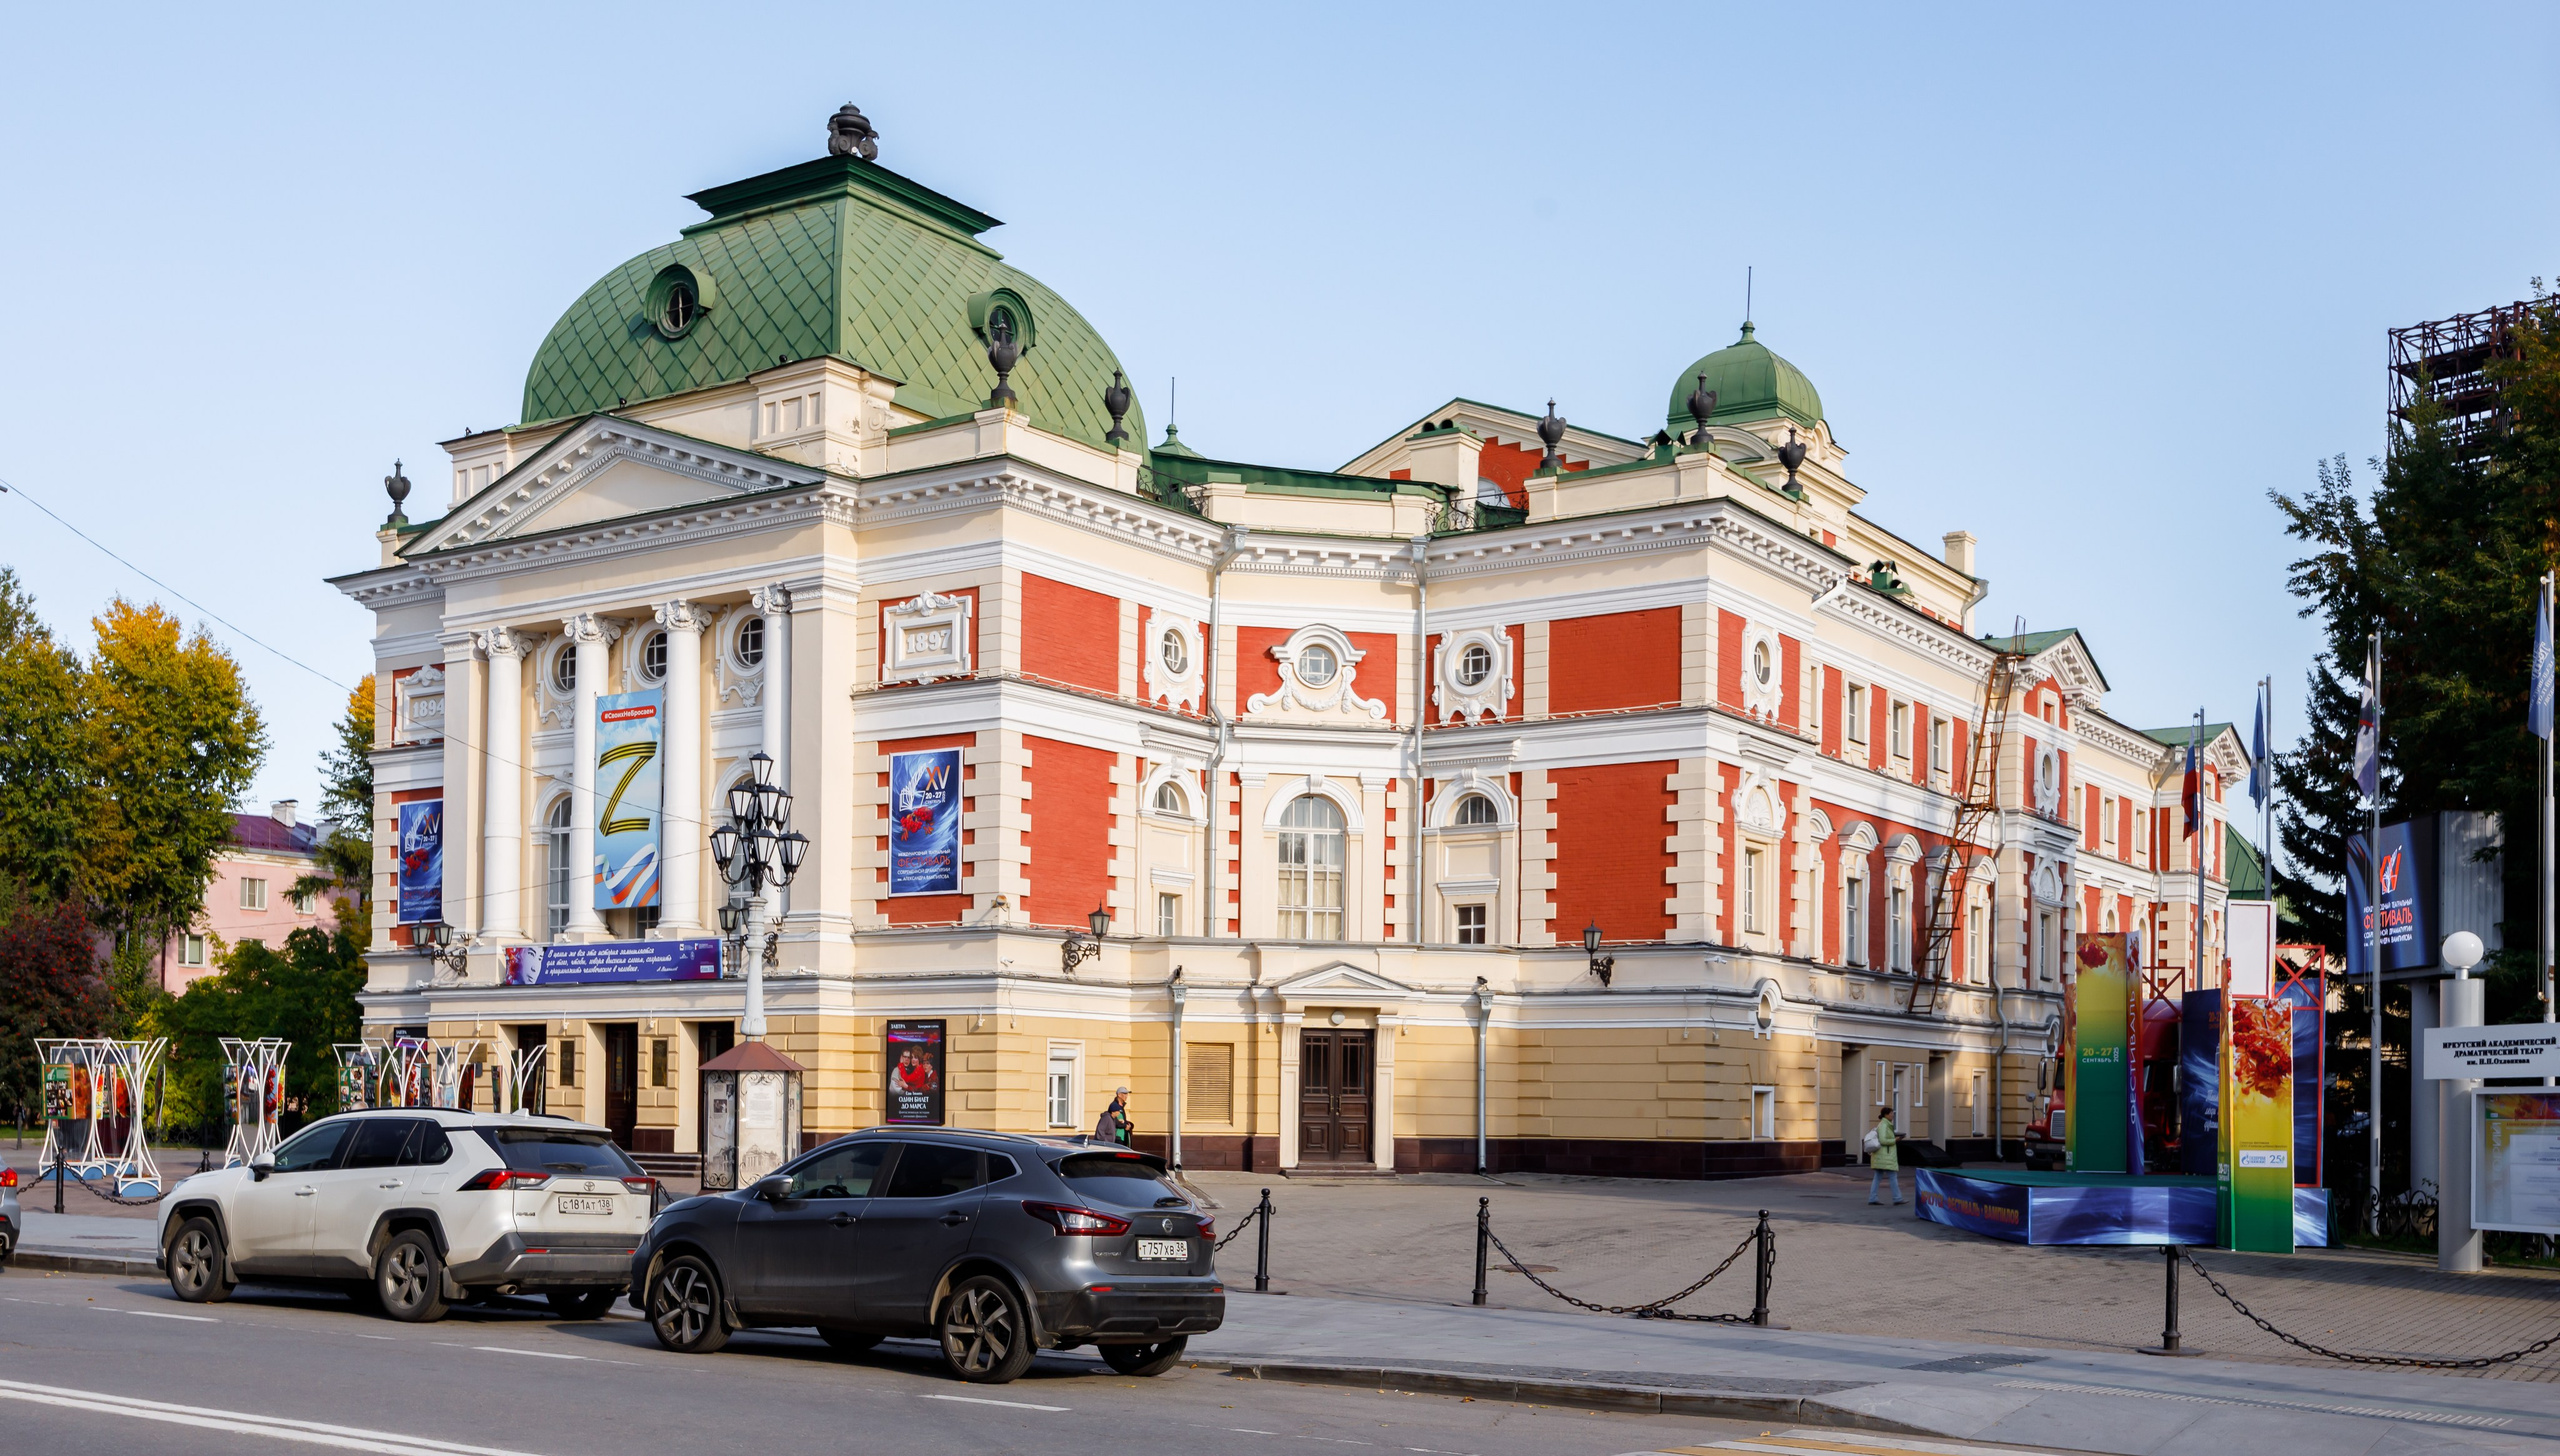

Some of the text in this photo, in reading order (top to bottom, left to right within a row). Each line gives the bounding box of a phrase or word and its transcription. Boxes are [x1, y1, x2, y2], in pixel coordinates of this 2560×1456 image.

[907, 628, 951, 653] 1897
[413, 698, 444, 719] 1894
[604, 708, 654, 719] #СвоихНеБросаем
[926, 765, 950, 791] XV
[423, 813, 440, 835] XV
[897, 855, 951, 868] ФЕСТИВАЛЬ
[2364, 907, 2413, 929] ФТИВАЛЬ
[2443, 1036, 2556, 1049] ИРКУТСКИЙ АКАДЕМИЧЕСКИЙ
[2454, 1047, 2518, 1058] ДРАМАТИЧЕСКИЙ
[2129, 991, 2137, 1124] ФЕСТИВАЛЬ
[1921, 1190, 2019, 1225] ИРКУТСК ФЕСТИВАЛЬ ВАМПИЛОВ
